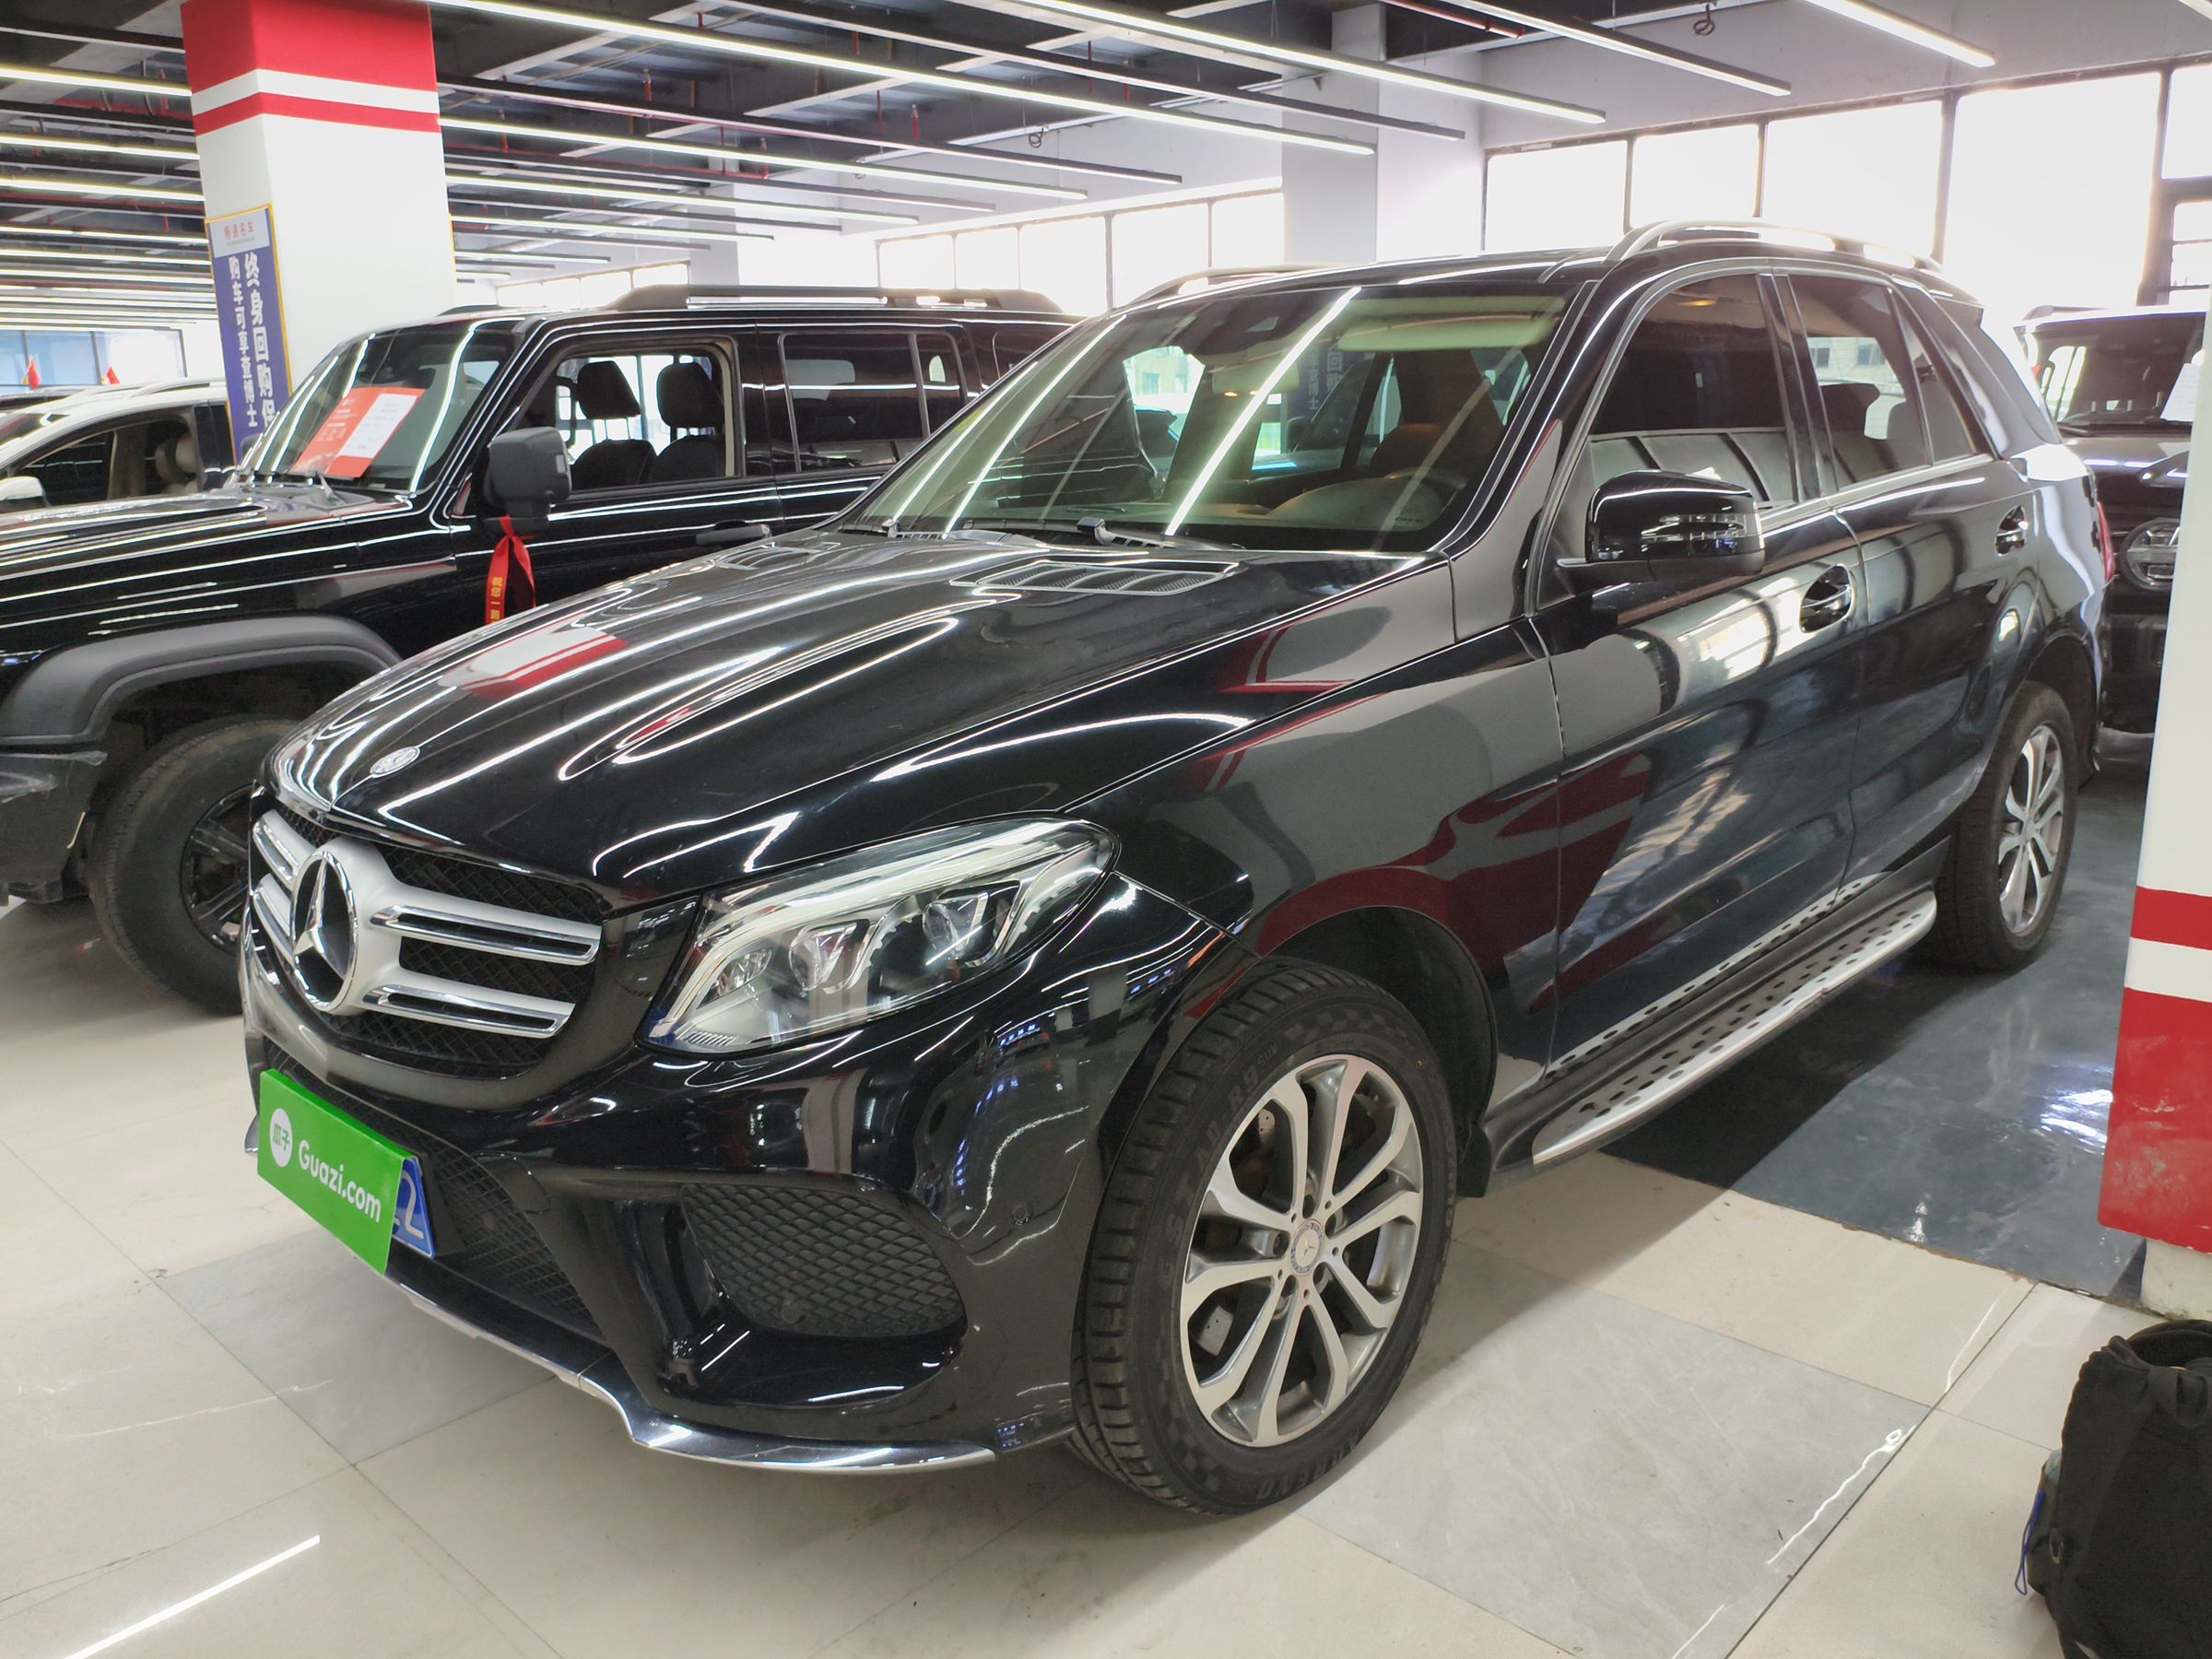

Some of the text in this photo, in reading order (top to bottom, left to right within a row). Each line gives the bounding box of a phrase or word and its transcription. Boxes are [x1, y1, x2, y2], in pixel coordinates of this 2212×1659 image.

[229, 255, 259, 428] 购车可享查博士
[299, 1139, 382, 1223] Guazi.com
[394, 1170, 425, 1240] 2
